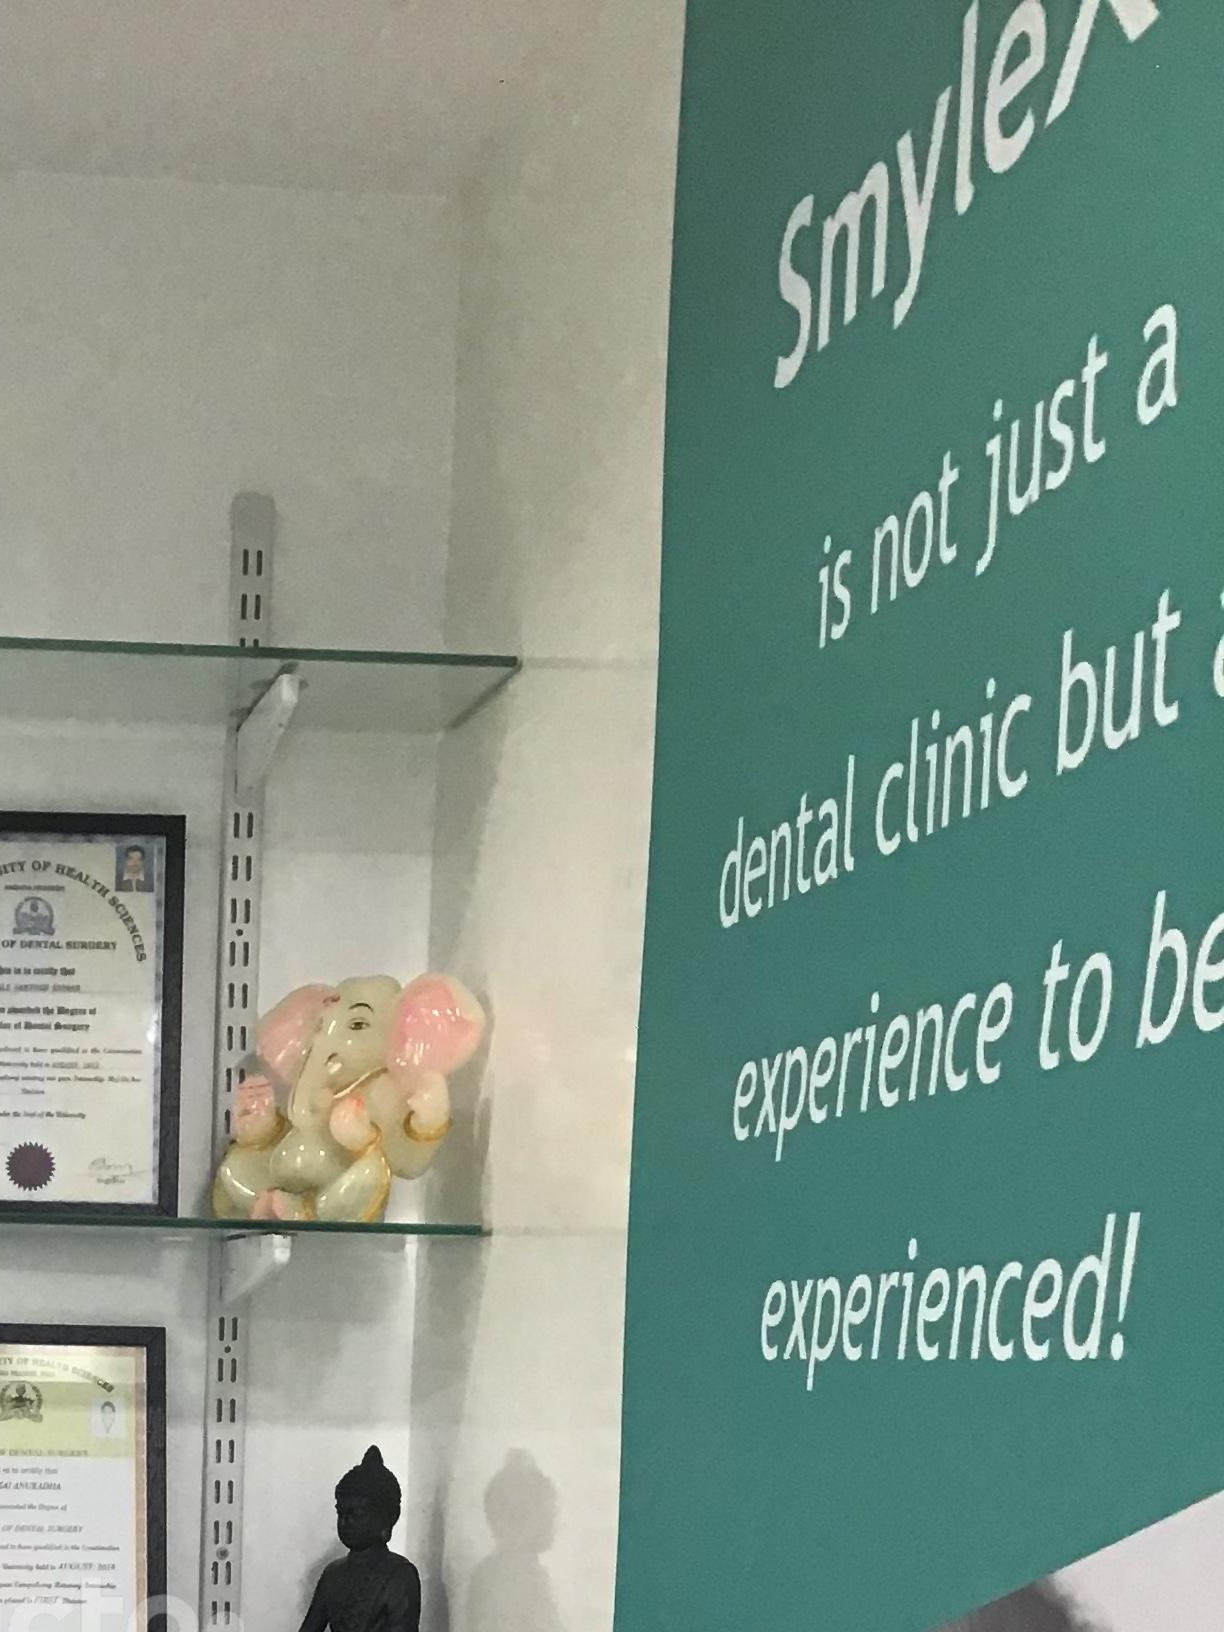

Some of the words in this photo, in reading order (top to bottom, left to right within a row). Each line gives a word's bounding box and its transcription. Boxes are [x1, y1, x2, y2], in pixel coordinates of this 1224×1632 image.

[819, 534, 851, 648] is
[871, 451, 959, 614] not
[976, 334, 1108, 576] just
[1136, 303, 1177, 425] a
[720, 754, 854, 928] dental
[876, 678, 1031, 856] clinic
[1057, 588, 1180, 776] but
[1, 939, 16, 949] OF
[20, 940, 62, 950] DENTAL
[65, 941, 117, 950] SURGERY
[31, 860, 52, 872] OF
[55, 863, 110, 898] HEALTH
[108, 896, 146, 962] SCIENCES
[732, 991, 1013, 1162] experience
[1039, 939, 1112, 1070] to
[1136, 890, 1224, 1049] be
[760, 1212, 1140, 1391] experienced!
